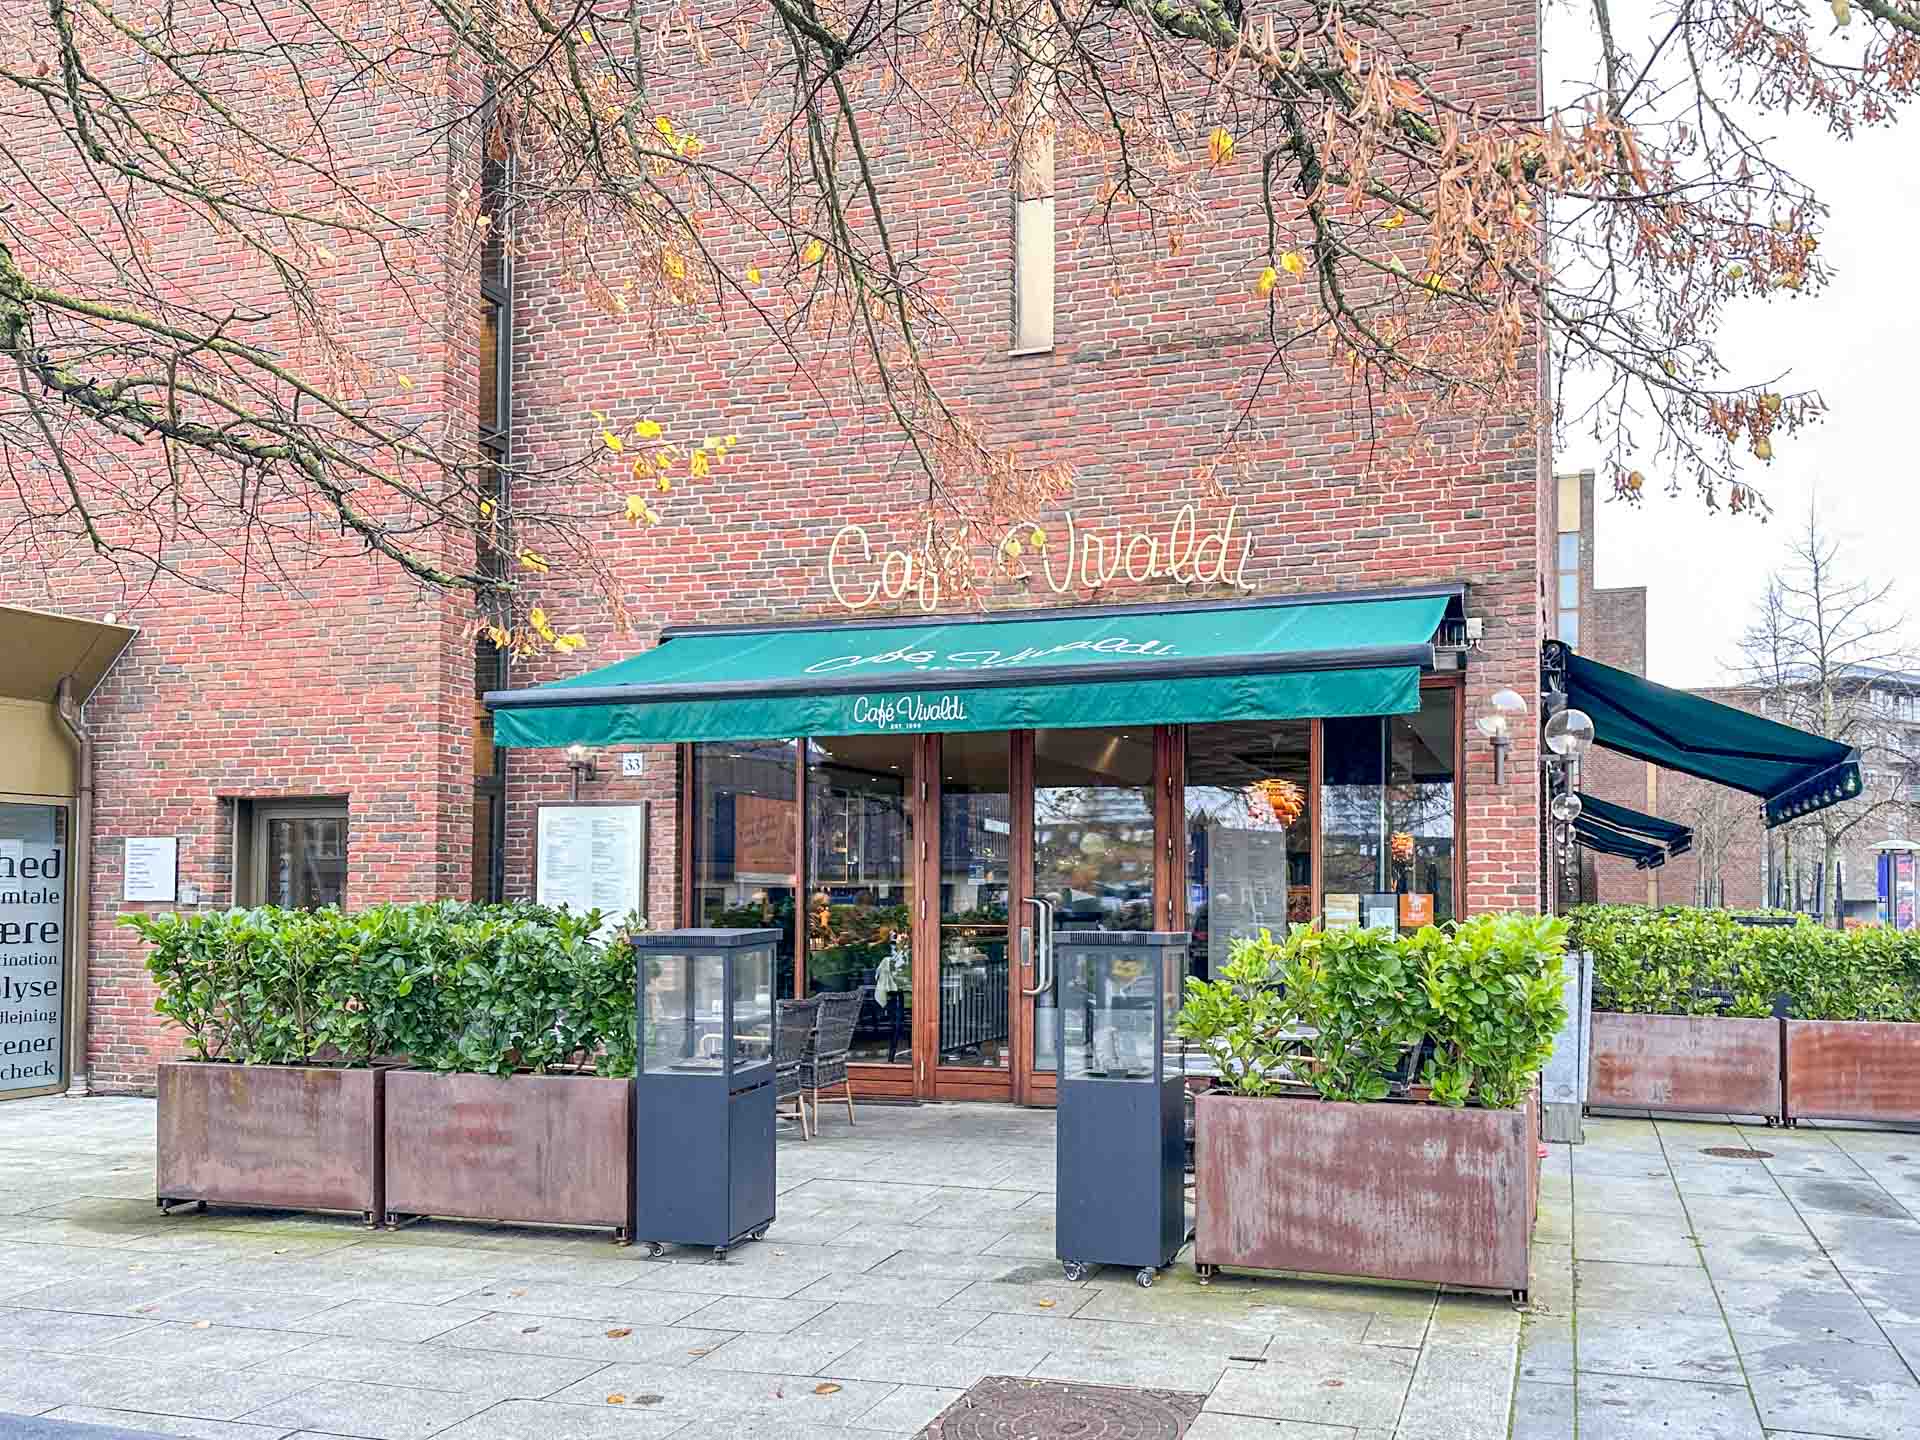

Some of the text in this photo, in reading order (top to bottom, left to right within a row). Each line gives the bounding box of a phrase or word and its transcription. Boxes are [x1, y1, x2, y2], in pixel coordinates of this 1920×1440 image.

[853, 695, 968, 729] Café Vivaldi
[625, 758, 641, 771] 33
[0, 952, 57, 967] ination
[0, 976, 58, 1003] lyse
[0, 1061, 56, 1080] check
